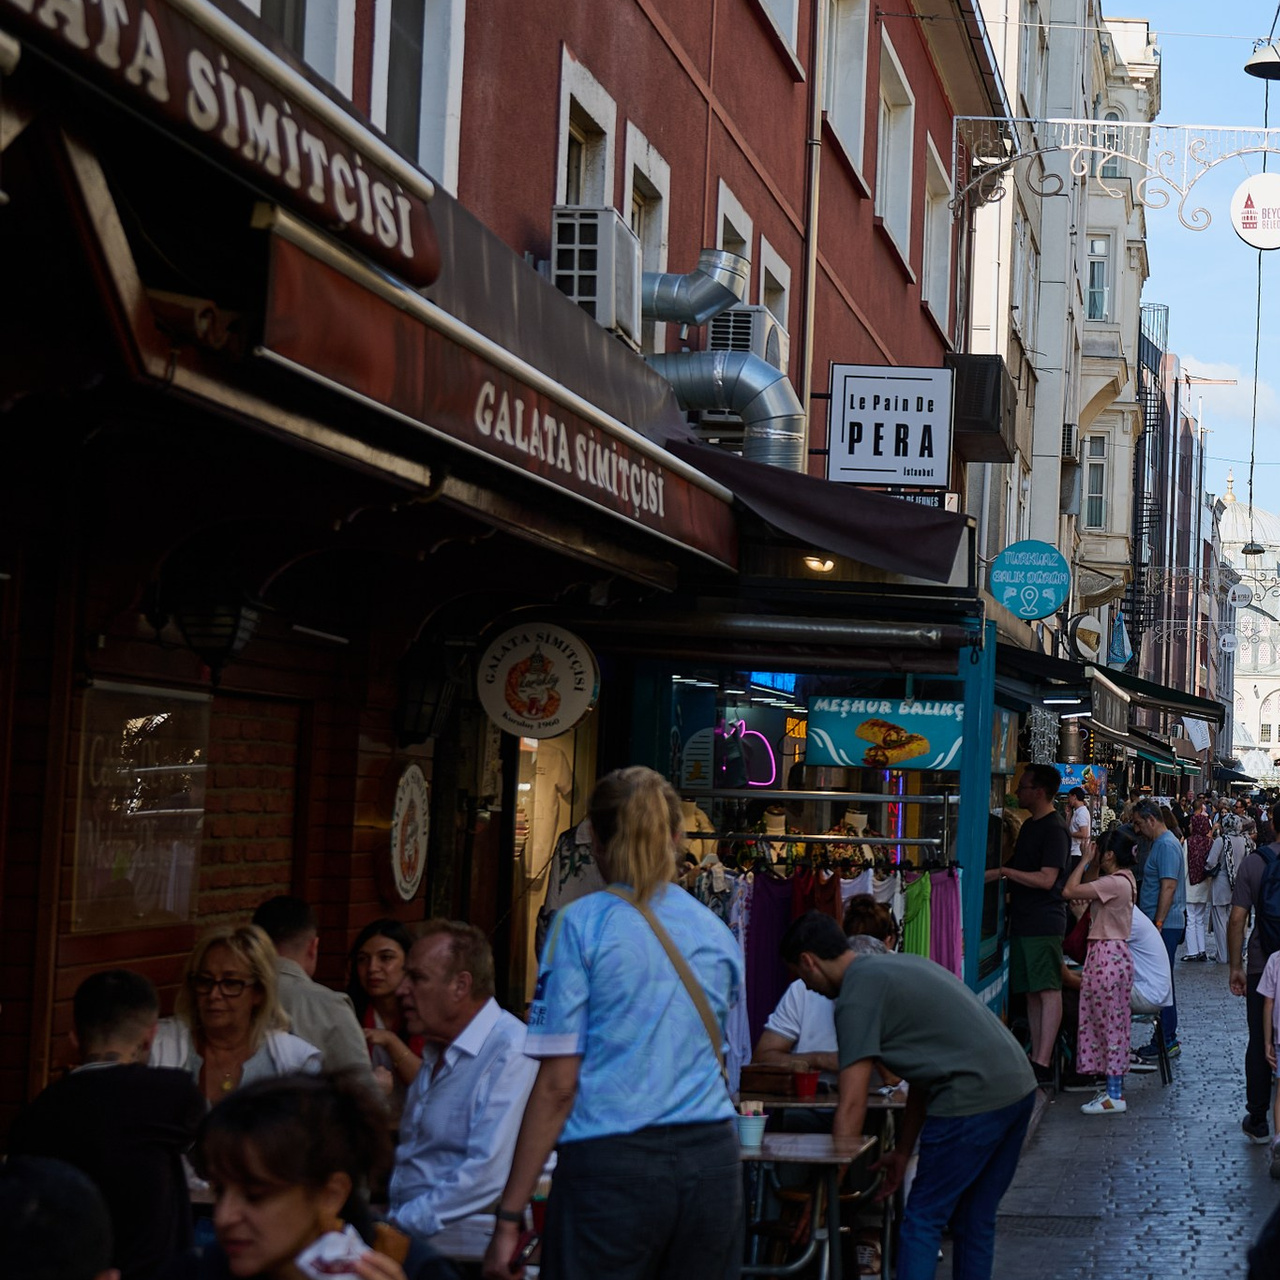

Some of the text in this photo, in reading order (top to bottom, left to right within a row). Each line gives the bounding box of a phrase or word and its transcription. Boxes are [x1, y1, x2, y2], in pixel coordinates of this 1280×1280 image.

[187, 48, 415, 260] SİMİTÇİSİ
[850, 394, 934, 413] Le Pain De
[474, 381, 665, 518] GALATA SİMİTÇİSİ
[848, 421, 934, 458] PERA
[485, 631, 586, 692] GALATA SİMİTÇİSİ
[537, 718, 560, 729] 1960
[814, 698, 893, 718] MEŞHUR
